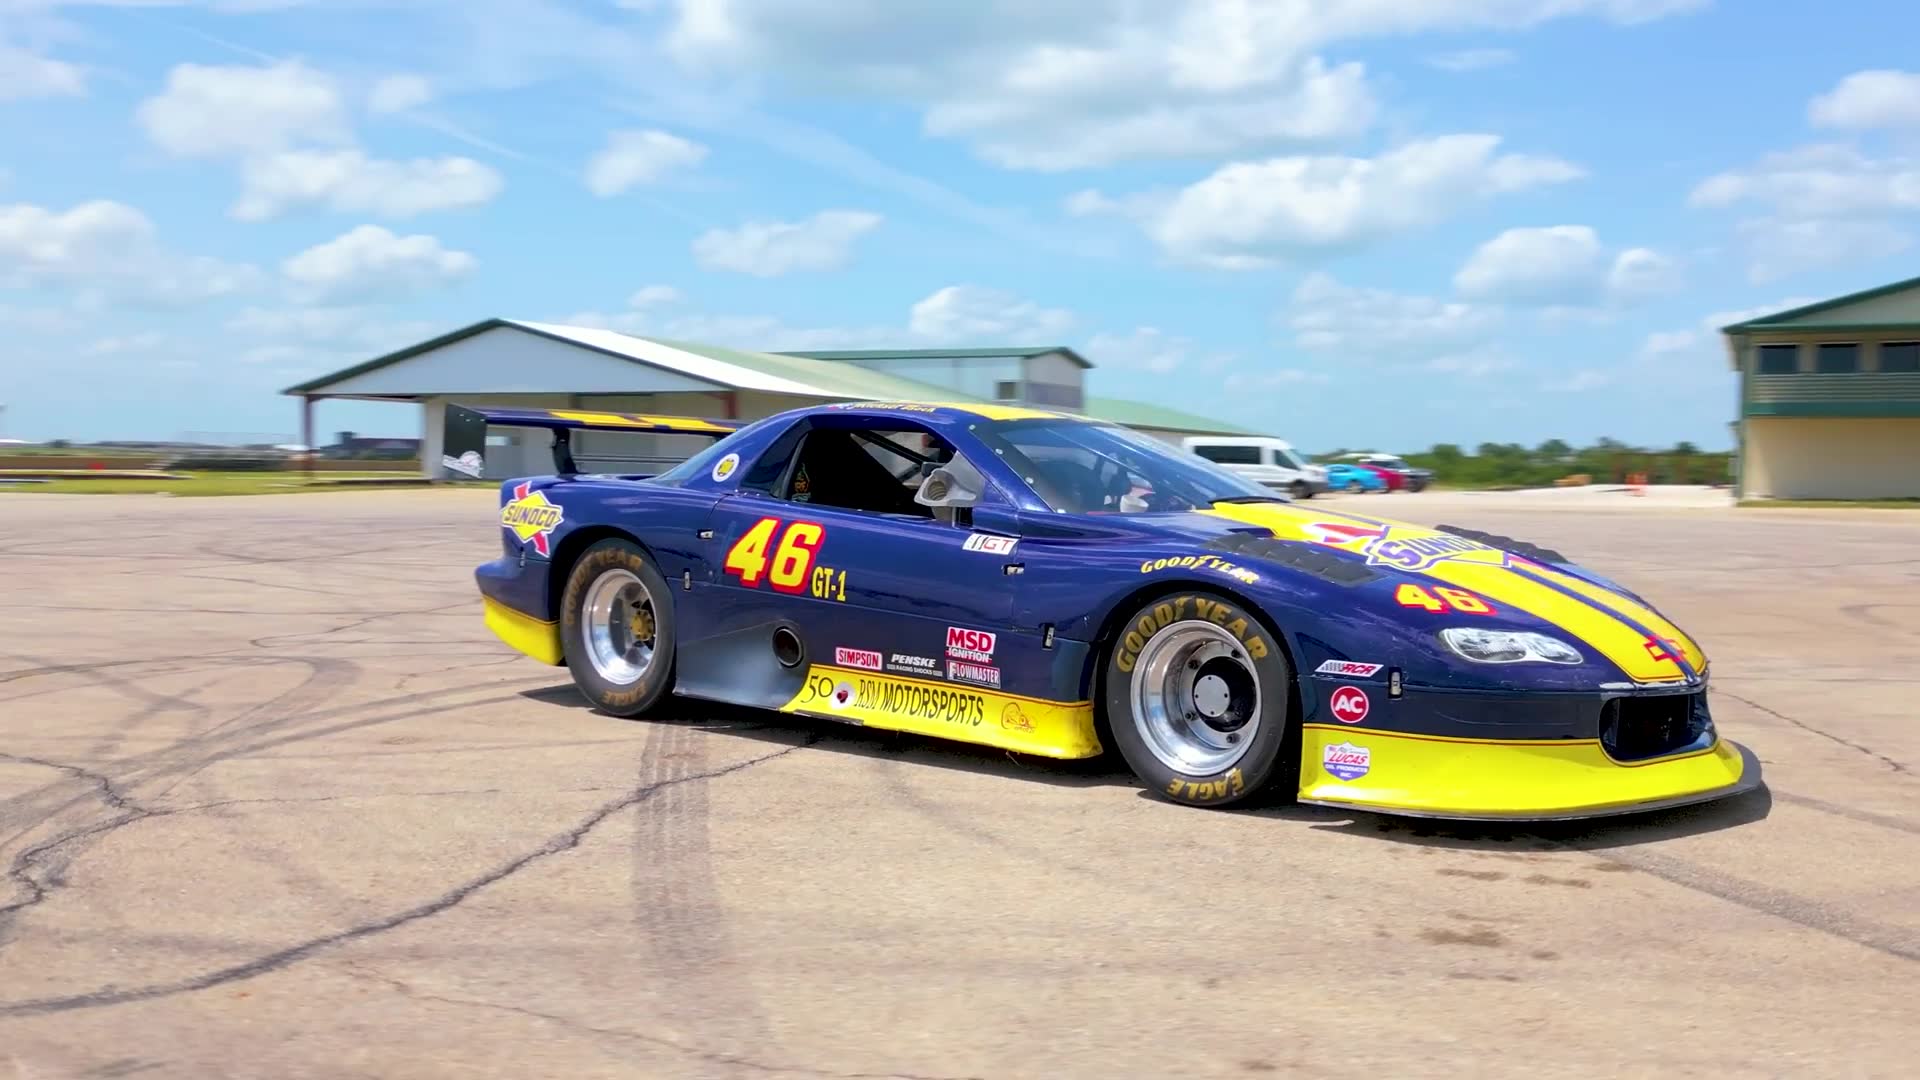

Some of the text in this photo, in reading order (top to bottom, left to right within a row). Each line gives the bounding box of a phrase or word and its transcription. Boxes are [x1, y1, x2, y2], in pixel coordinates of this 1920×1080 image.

[504, 505, 558, 528] SUNOCO
[724, 516, 826, 595] 46
[1140, 555, 1260, 585] GOODYEAR
[811, 566, 847, 601] GT-1
[1395, 583, 1498, 616] 46
[949, 628, 993, 652] MSD
[1116, 596, 1268, 673] GOODYEAR
[838, 649, 880, 667] SIMPSON
[891, 653, 936, 668] PENSKE
[949, 648, 990, 663] IGNITION
[949, 661, 999, 684] FLOWMASTER
[880, 681, 984, 727] MOTORSPORTS
[1335, 694, 1364, 713] AC
[1328, 752, 1368, 765] LUCAS
[1167, 767, 1246, 800] EAGLE
